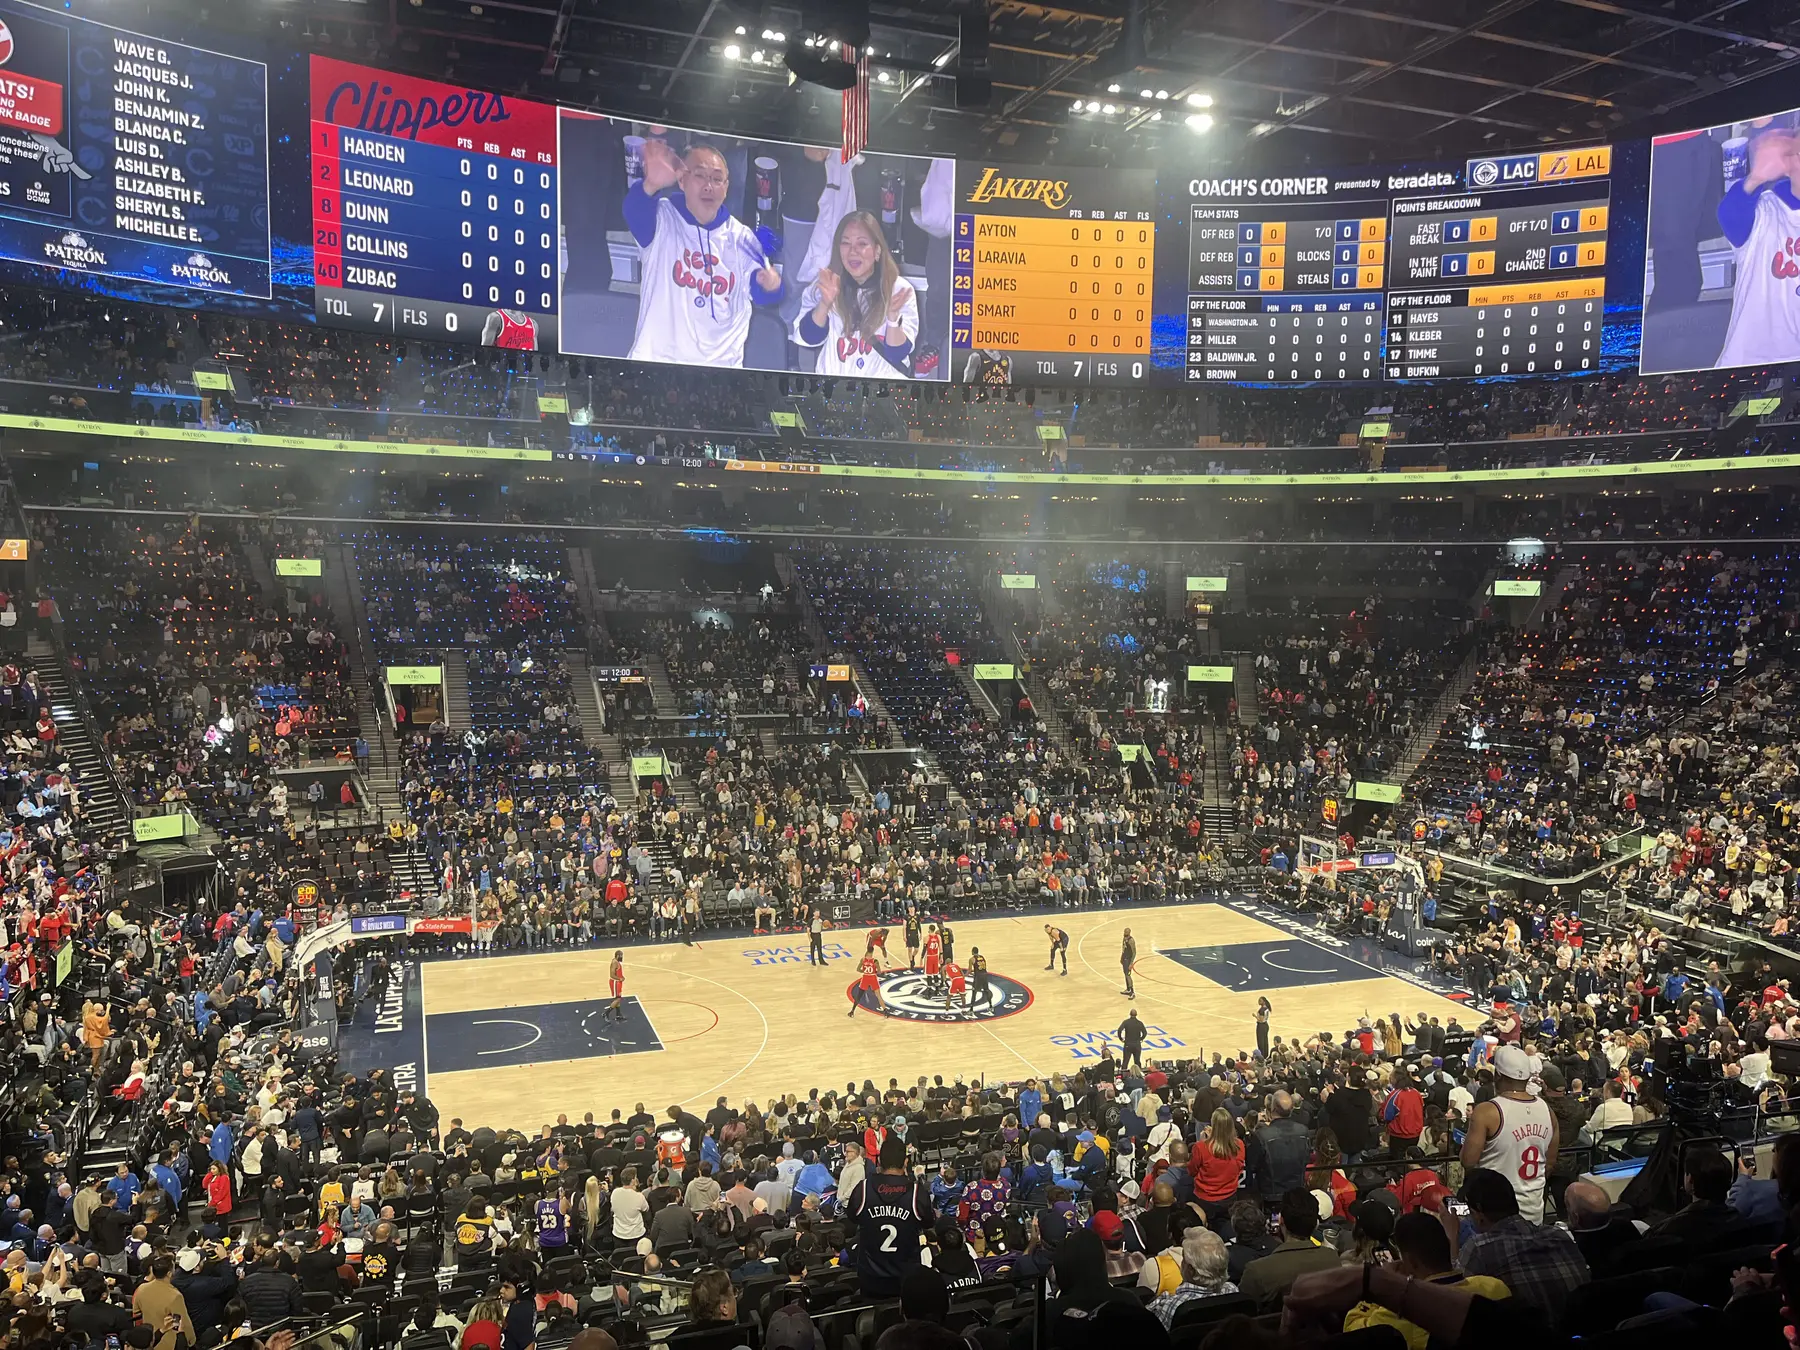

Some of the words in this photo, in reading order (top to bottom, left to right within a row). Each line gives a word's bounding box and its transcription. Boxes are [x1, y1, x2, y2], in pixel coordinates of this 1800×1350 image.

[114, 38, 156, 62] WAVE
[157, 48, 171, 65] G.
[114, 60, 179, 85] JACQUES
[180, 75, 194, 90] J.
[114, 79, 154, 100] JOHN
[156, 88, 170, 103] K.
[114, 98, 189, 127] BENJAMIN
[192, 115, 204, 130] Z.
[324, 80, 511, 140] Clippers
[16, 111, 50, 127] BADGE
[115, 118, 172, 143] BLANCA
[174, 131, 187, 145] C.
[14, 148, 38, 160] these
[115, 136, 148, 156] LUIS
[150, 144, 164, 159] D.
[321, 133, 328, 147] 1
[344, 136, 405, 164] HARDEN
[458, 137, 472, 150] PTS
[484, 142, 500, 154] REB
[511, 148, 526, 159] AST
[538, 152, 552, 164] FLS
[115, 158, 170, 180] ASHLEY
[172, 168, 186, 182] B.
[1503, 162, 1534, 180] LAC
[1576, 155, 1606, 172] LAL
[321, 166, 330, 180] 2
[345, 168, 414, 196] LEONARD
[1260, 178, 1328, 196] CORNER
[1334, 180, 1370, 190] presented
[1371, 179, 1381, 189] by
[116, 176, 191, 202] ELIZABETH
[194, 191, 205, 206] F.
[116, 196, 170, 218] SHERYL
[172, 205, 185, 220] S.
[321, 198, 332, 214] 8
[346, 202, 388, 224] DUNN
[1396, 202, 1426, 214] POINTS
[1427, 198, 1481, 211] BREAKDOWN
[1070, 210, 1082, 218] PTS
[1092, 210, 1105, 220] REB
[1114, 211, 1128, 220] AST
[1138, 212, 1150, 220] FLS
[1194, 210, 1216, 218] TEAM
[1216, 210, 1239, 218] STATS
[116, 215, 186, 240] MICHELLE
[189, 228, 202, 242] E.
[960, 222, 968, 236] 5
[978, 224, 1016, 238] AYTON
[1418, 223, 1440, 234] FAST
[1510, 221, 1528, 232] OFF
[1530, 218, 1547, 230] T/O
[1201, 229, 1217, 240] OFF
[1218, 228, 1234, 240] REB
[1315, 227, 1332, 238] T/O
[316, 230, 338, 246] 20
[346, 234, 408, 258] COLLINS
[1410, 234, 1440, 246] BREAK
[956, 248, 970, 262] 12
[978, 250, 1026, 266] LARAVIA
[1200, 252, 1216, 262] DEF
[1218, 252, 1234, 262] REB
[1296, 250, 1330, 261] BLOCKS
[1526, 249, 1546, 260] 2ND
[62, 260, 87, 269] TEQUILA
[1410, 258, 1419, 269] IN
[1420, 256, 1438, 268] THE
[1506, 260, 1545, 272] CHANCE
[318, 263, 338, 280] 40
[347, 266, 396, 288] ZUBAC
[1298, 274, 1330, 284] STEALS
[1410, 267, 1437, 278] PAINT
[954, 276, 971, 290] 23
[978, 278, 1017, 291] JAMES
[1198, 275, 1232, 285] ASSISTS
[1190, 301, 1204, 310] OFF
[1206, 301, 1220, 310] THE
[1222, 301, 1246, 310] FLOOR
[1267, 304, 1280, 312] MIN
[1364, 302, 1375, 310] FLS
[1390, 298, 1406, 306] OFF
[1407, 296, 1423, 306] THE
[1424, 294, 1452, 305] FLOOR
[324, 298, 352, 317] TOL
[372, 304, 384, 323] 7
[404, 309, 428, 326] FLS
[446, 312, 458, 332] 0
[954, 302, 970, 316] 36
[977, 304, 1016, 318] SMART
[1192, 318, 1202, 327] 15
[1392, 314, 1402, 324] 11
[1410, 312, 1438, 324] HAYES
[954, 330, 970, 343] 77
[976, 330, 1020, 344] DONCIC
[1190, 336, 1202, 344] 22
[1208, 336, 1236, 344] MILLER
[1390, 332, 1402, 342] 14
[1409, 330, 1442, 342] KLEBER
[1190, 352, 1201, 362] 23
[1207, 353, 1244, 362] BALDWIN
[1390, 350, 1400, 360] 17
[1408, 348, 1437, 360] TIMME
[1037, 361, 1058, 374] TOL
[1074, 361, 1083, 377] 7
[1098, 362, 1118, 376] FLS
[1132, 362, 1142, 378] 0
[1189, 370, 1200, 379] 24
[1206, 370, 1236, 379] BROWN
[1389, 368, 1400, 378] 18
[1408, 366, 1440, 377] BUFKIN
[682, 459, 702, 468] 12:00
[368, 922, 382, 930] RIVALS
[1230, 901, 1258, 912] LA
[1254, 910, 1350, 948] CLIPPERS
[864, 966, 874, 974] 20
[1004, 992, 1024, 1010] LOS
[1512, 1124, 1549, 1142] HAROLD
[1002, 1144, 1020, 1156] 24
[1518, 1146, 1538, 1180] 8
[868, 1206, 910, 1220] LEONARD
[540, 1214, 557, 1228] 23
[880, 1224, 898, 1252] 2
